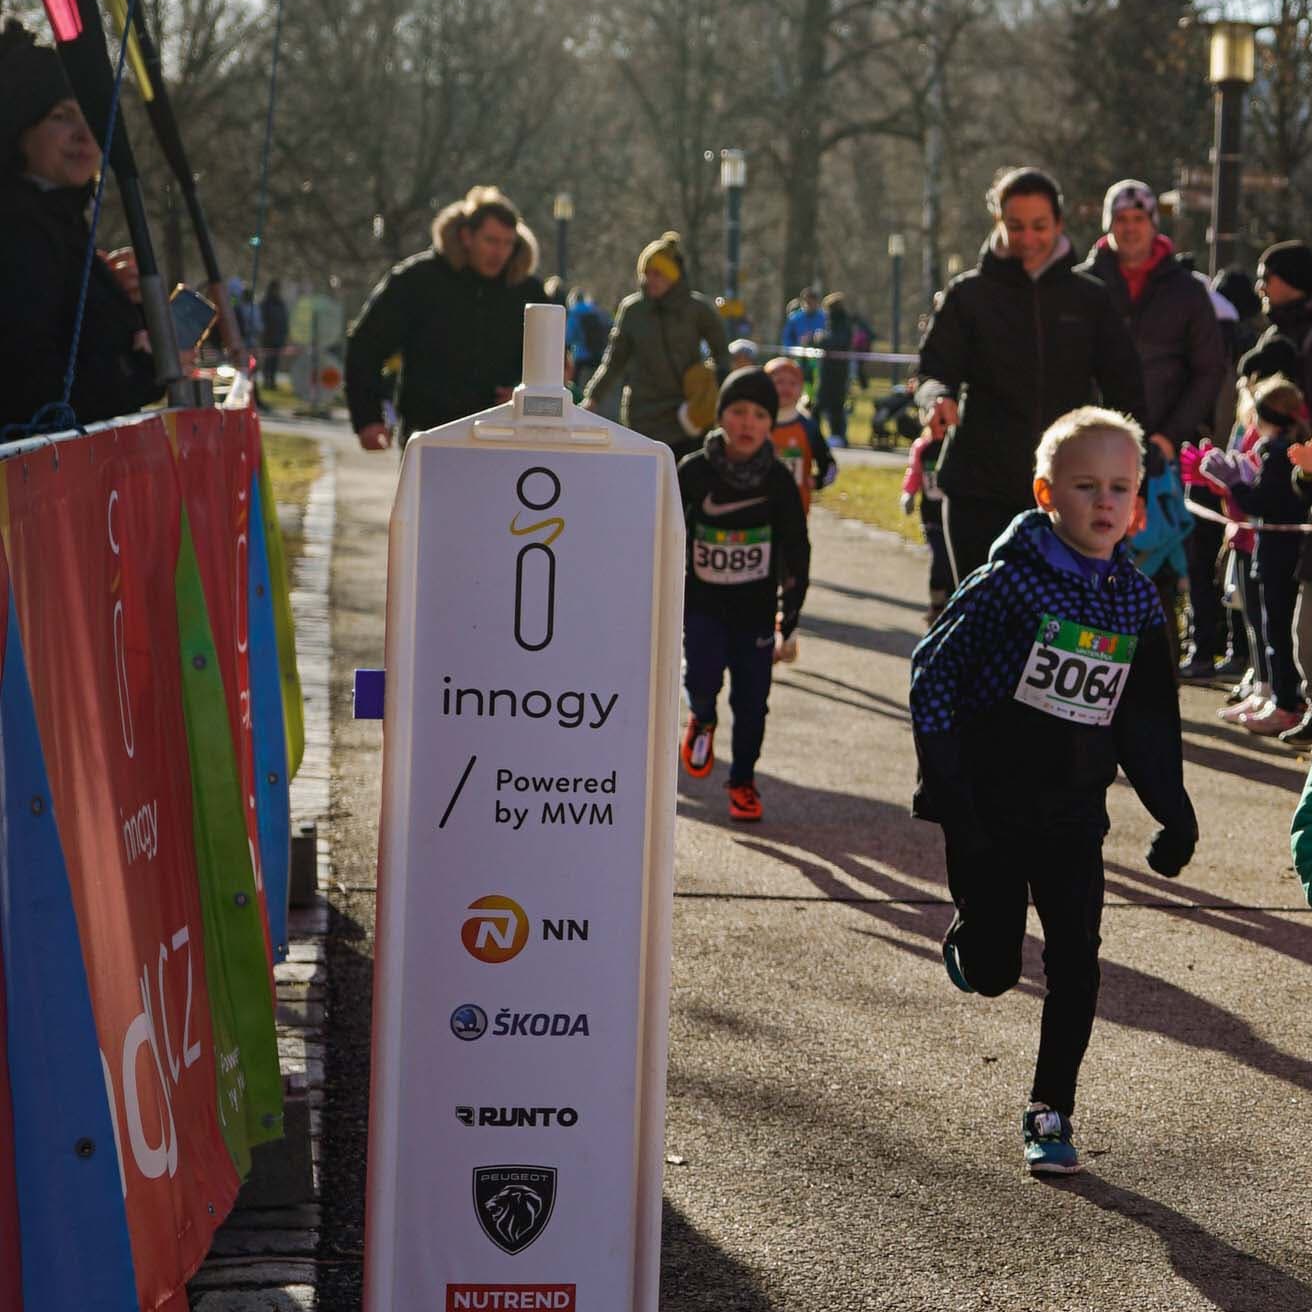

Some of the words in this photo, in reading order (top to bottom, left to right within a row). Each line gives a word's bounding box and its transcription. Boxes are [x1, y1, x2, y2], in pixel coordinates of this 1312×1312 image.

[696, 545, 763, 571] 3089
[1025, 648, 1123, 706] 3064
[442, 676, 619, 729] innogy
[496, 768, 617, 794] Powered
[495, 800, 529, 830] by
[541, 803, 613, 826] MVM
[542, 919, 589, 941] NN
[492, 1008, 590, 1037] ŠKODA
[479, 1107, 578, 1127] RUNTO
[480, 1172, 550, 1182] PEUGEOT
[453, 1290, 571, 1310] NUTREND
